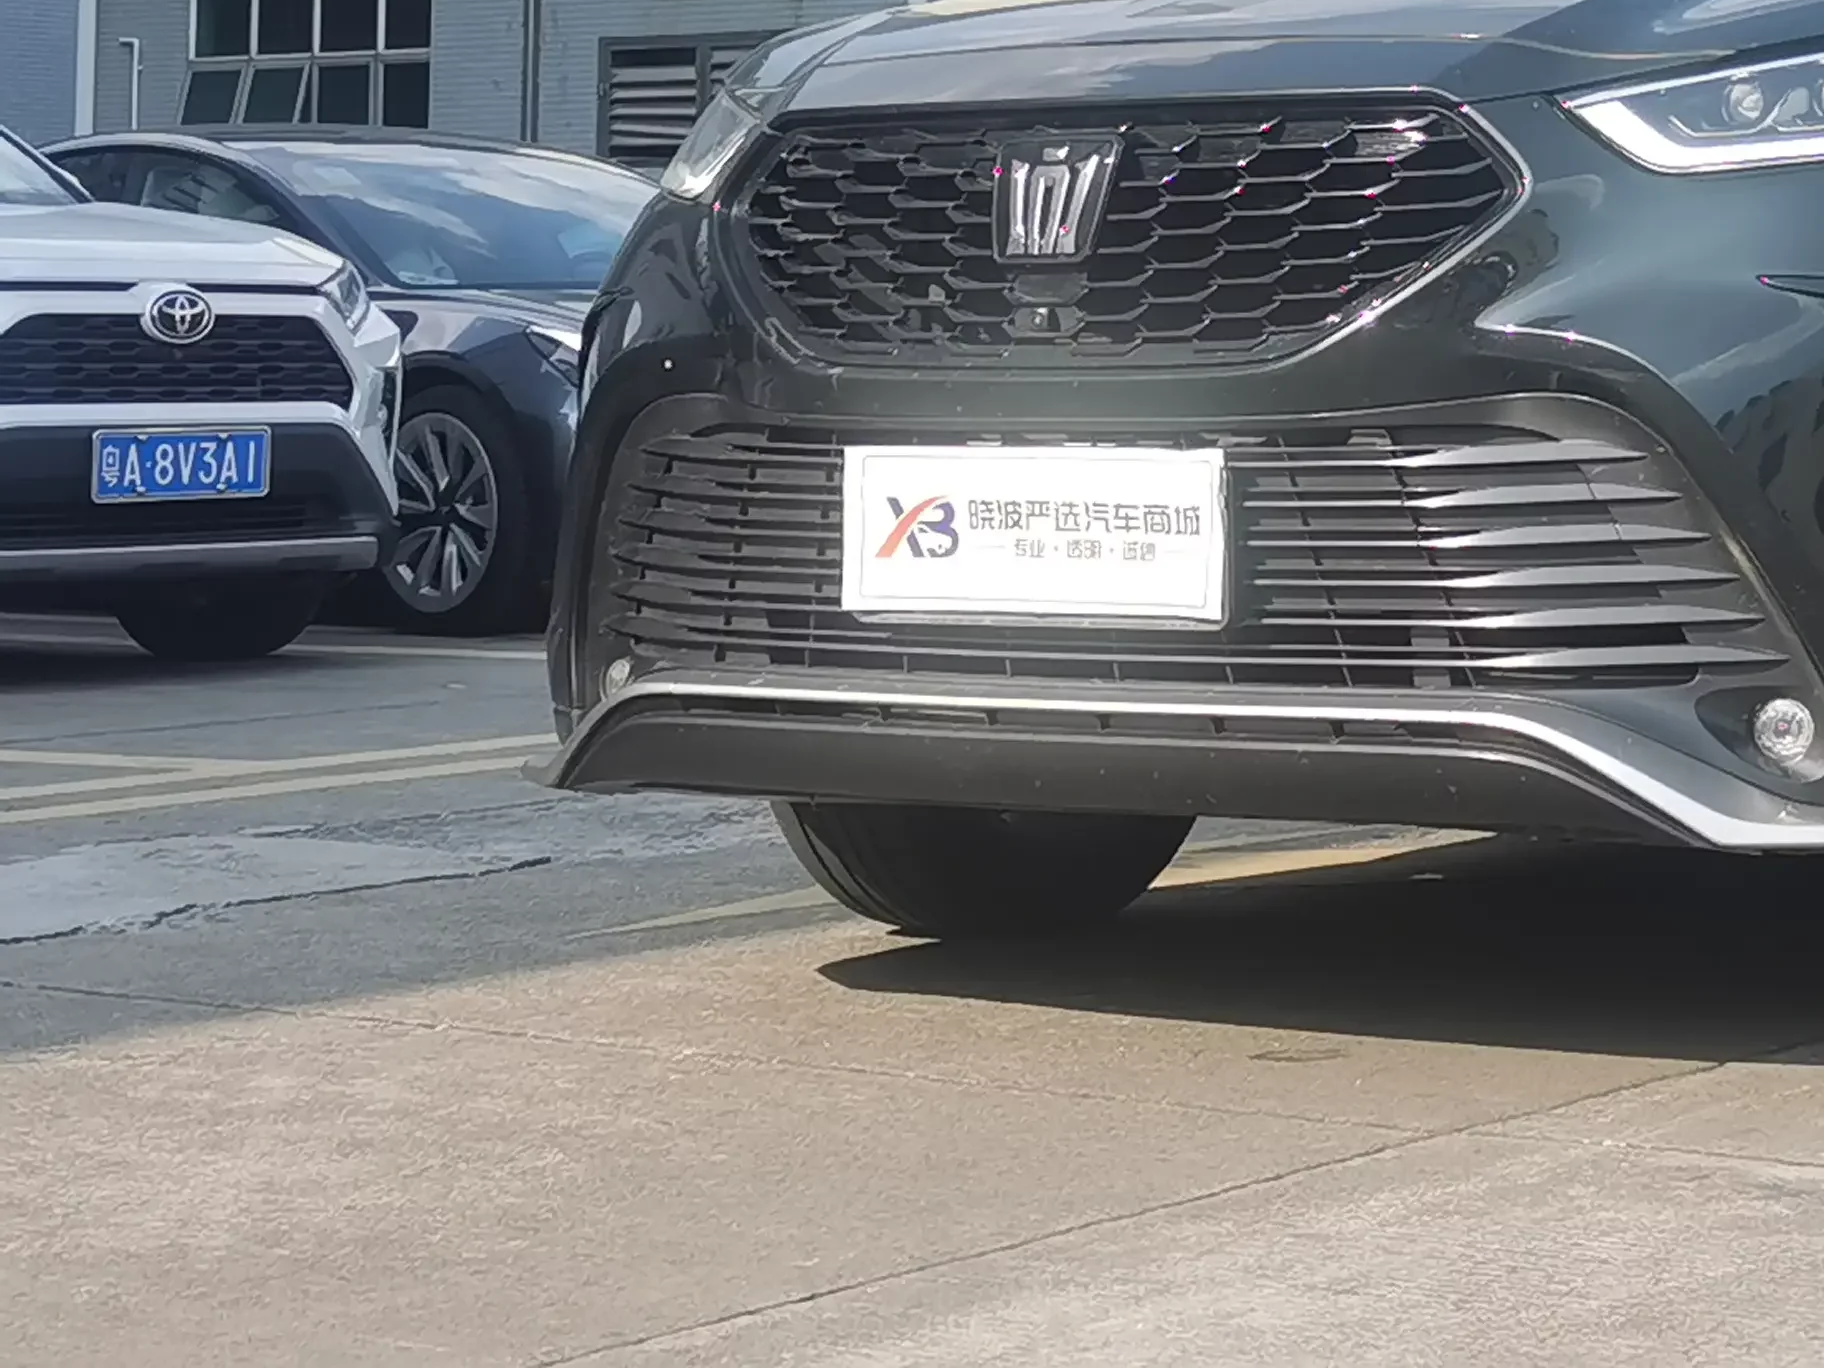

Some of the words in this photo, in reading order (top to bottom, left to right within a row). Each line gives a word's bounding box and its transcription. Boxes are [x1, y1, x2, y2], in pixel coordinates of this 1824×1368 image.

[968, 499, 1201, 536] 晓波严选汽车商城
